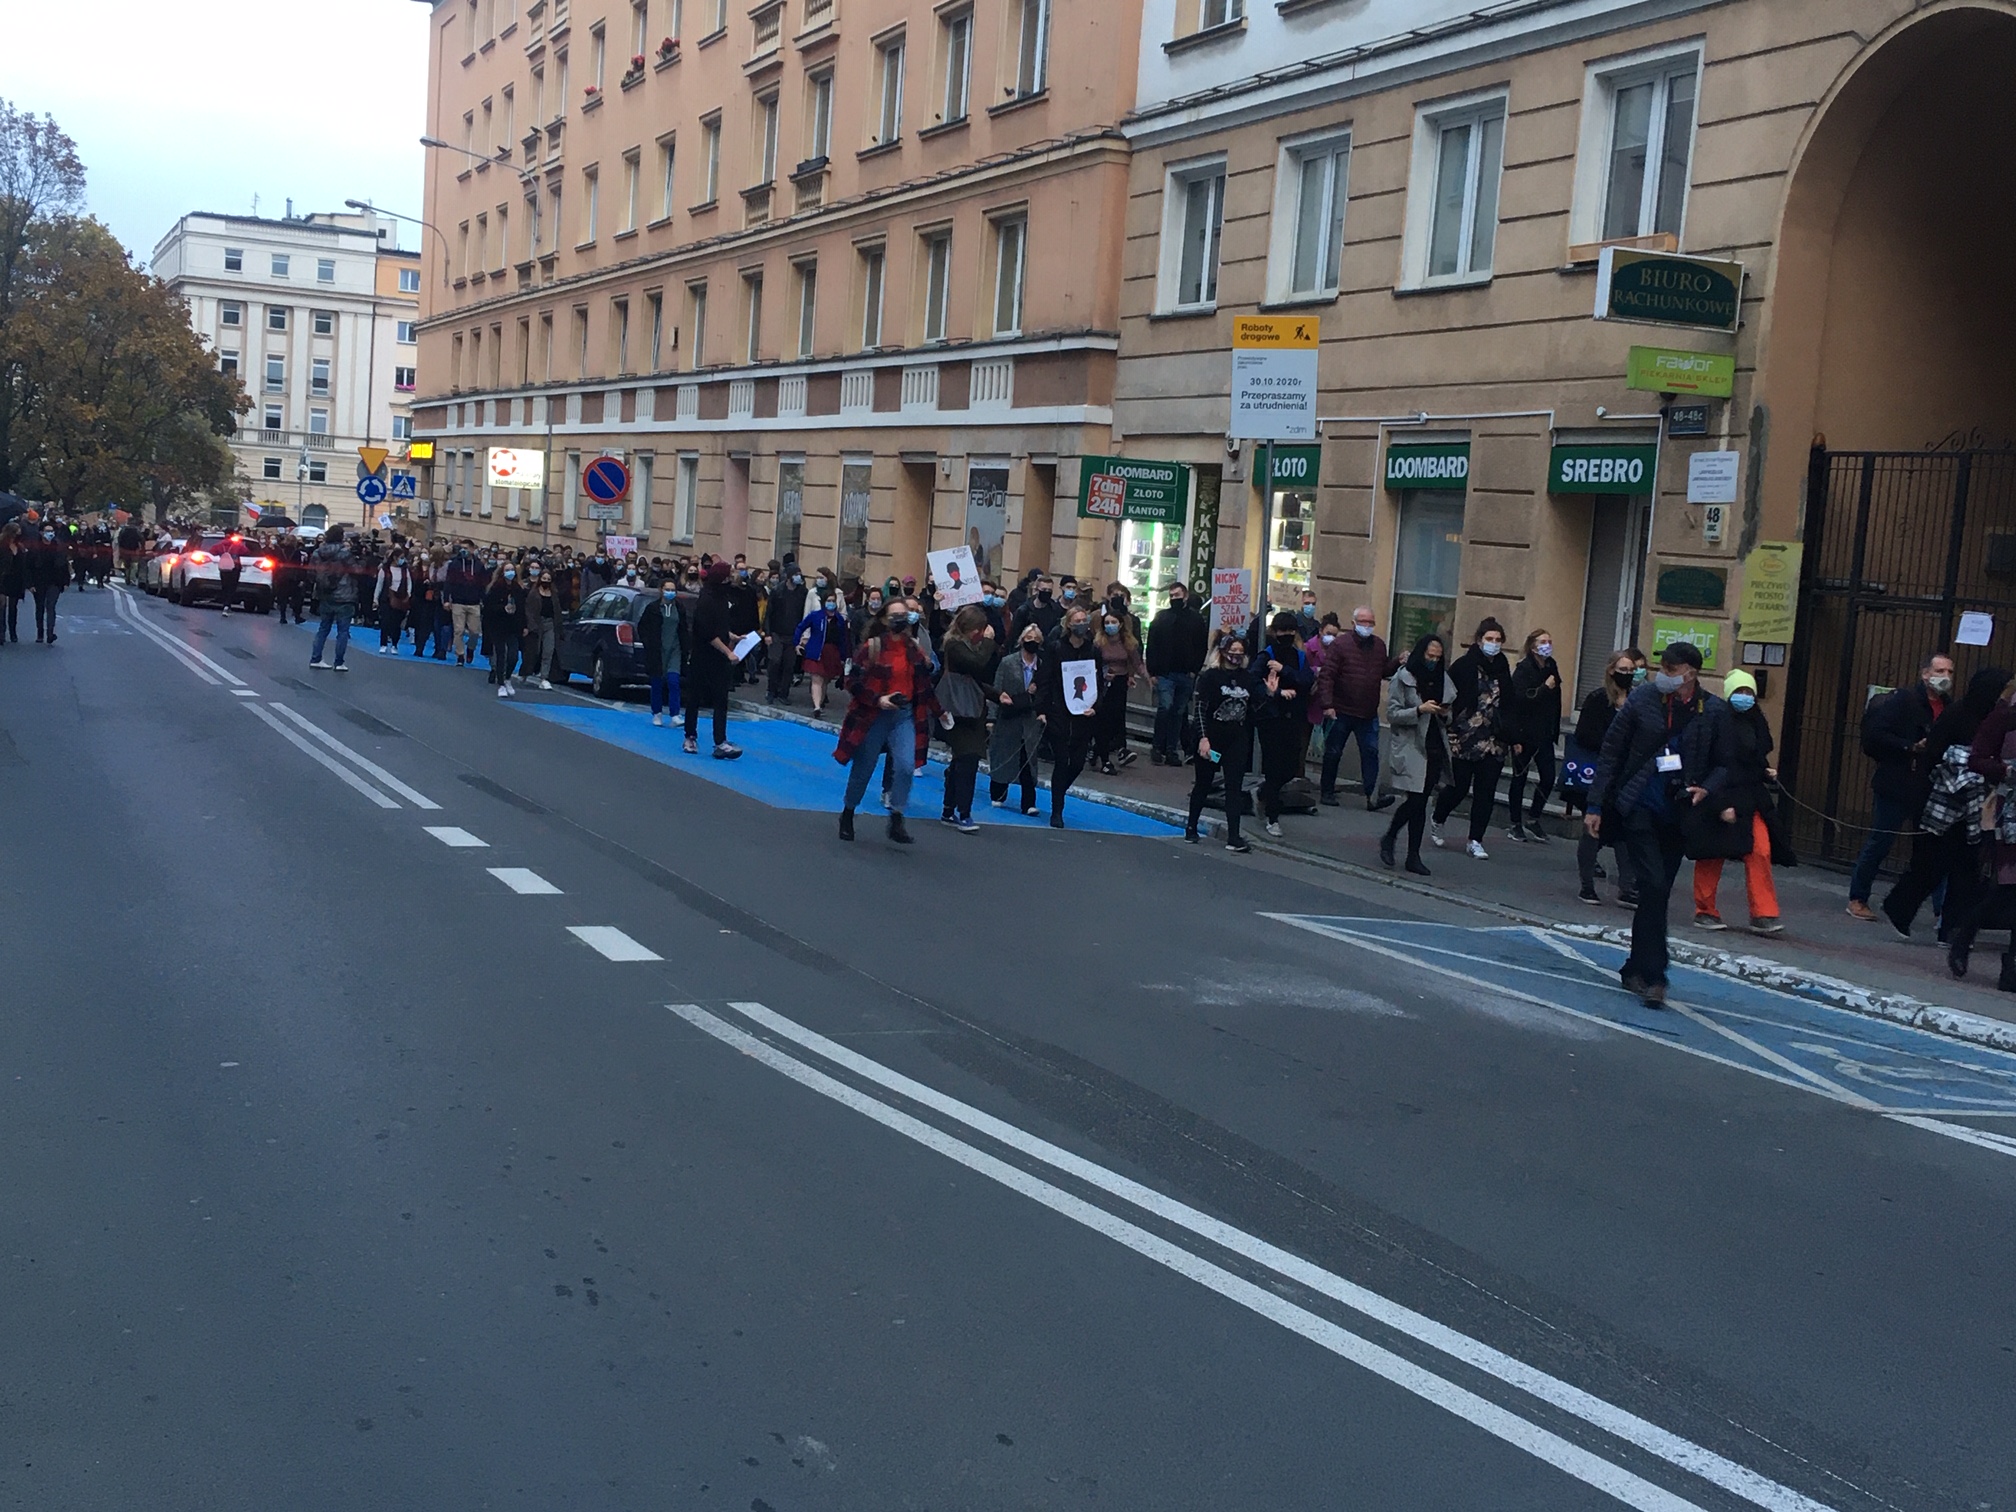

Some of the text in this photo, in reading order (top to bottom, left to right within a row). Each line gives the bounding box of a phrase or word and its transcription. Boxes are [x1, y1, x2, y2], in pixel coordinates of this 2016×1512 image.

[1639, 267, 1712, 293] BIURO
[1613, 289, 1734, 315] RACHUNKOWE
[1241, 323, 1274, 333] Roboty
[1240, 332, 1280, 342] drogowe
[1640, 368, 1728, 384] PIEKARNIA SKLEP
[1250, 378, 1302, 386] 30.10.2020r
[1241, 391, 1307, 402] Przepraszamy
[1253, 401, 1308, 410] utrudnienia!
[1289, 425, 1307, 434] zdm
[1109, 465, 1174, 481] LOOMBARD
[1387, 456, 1469, 479] LOOMBARD
[1561, 458, 1644, 483] SREBRO
[1089, 496, 1120, 515] 24h
[1128, 506, 1166, 517] KANTOR
[1706, 507, 1720, 523] 48
[1194, 514, 1212, 602] KANTO
[1229, 584, 1243, 595] NIE
[1750, 580, 1791, 591] PIECZYWO
[1754, 591, 1784, 601] PROSTO
[1748, 601, 1754, 610] Z
